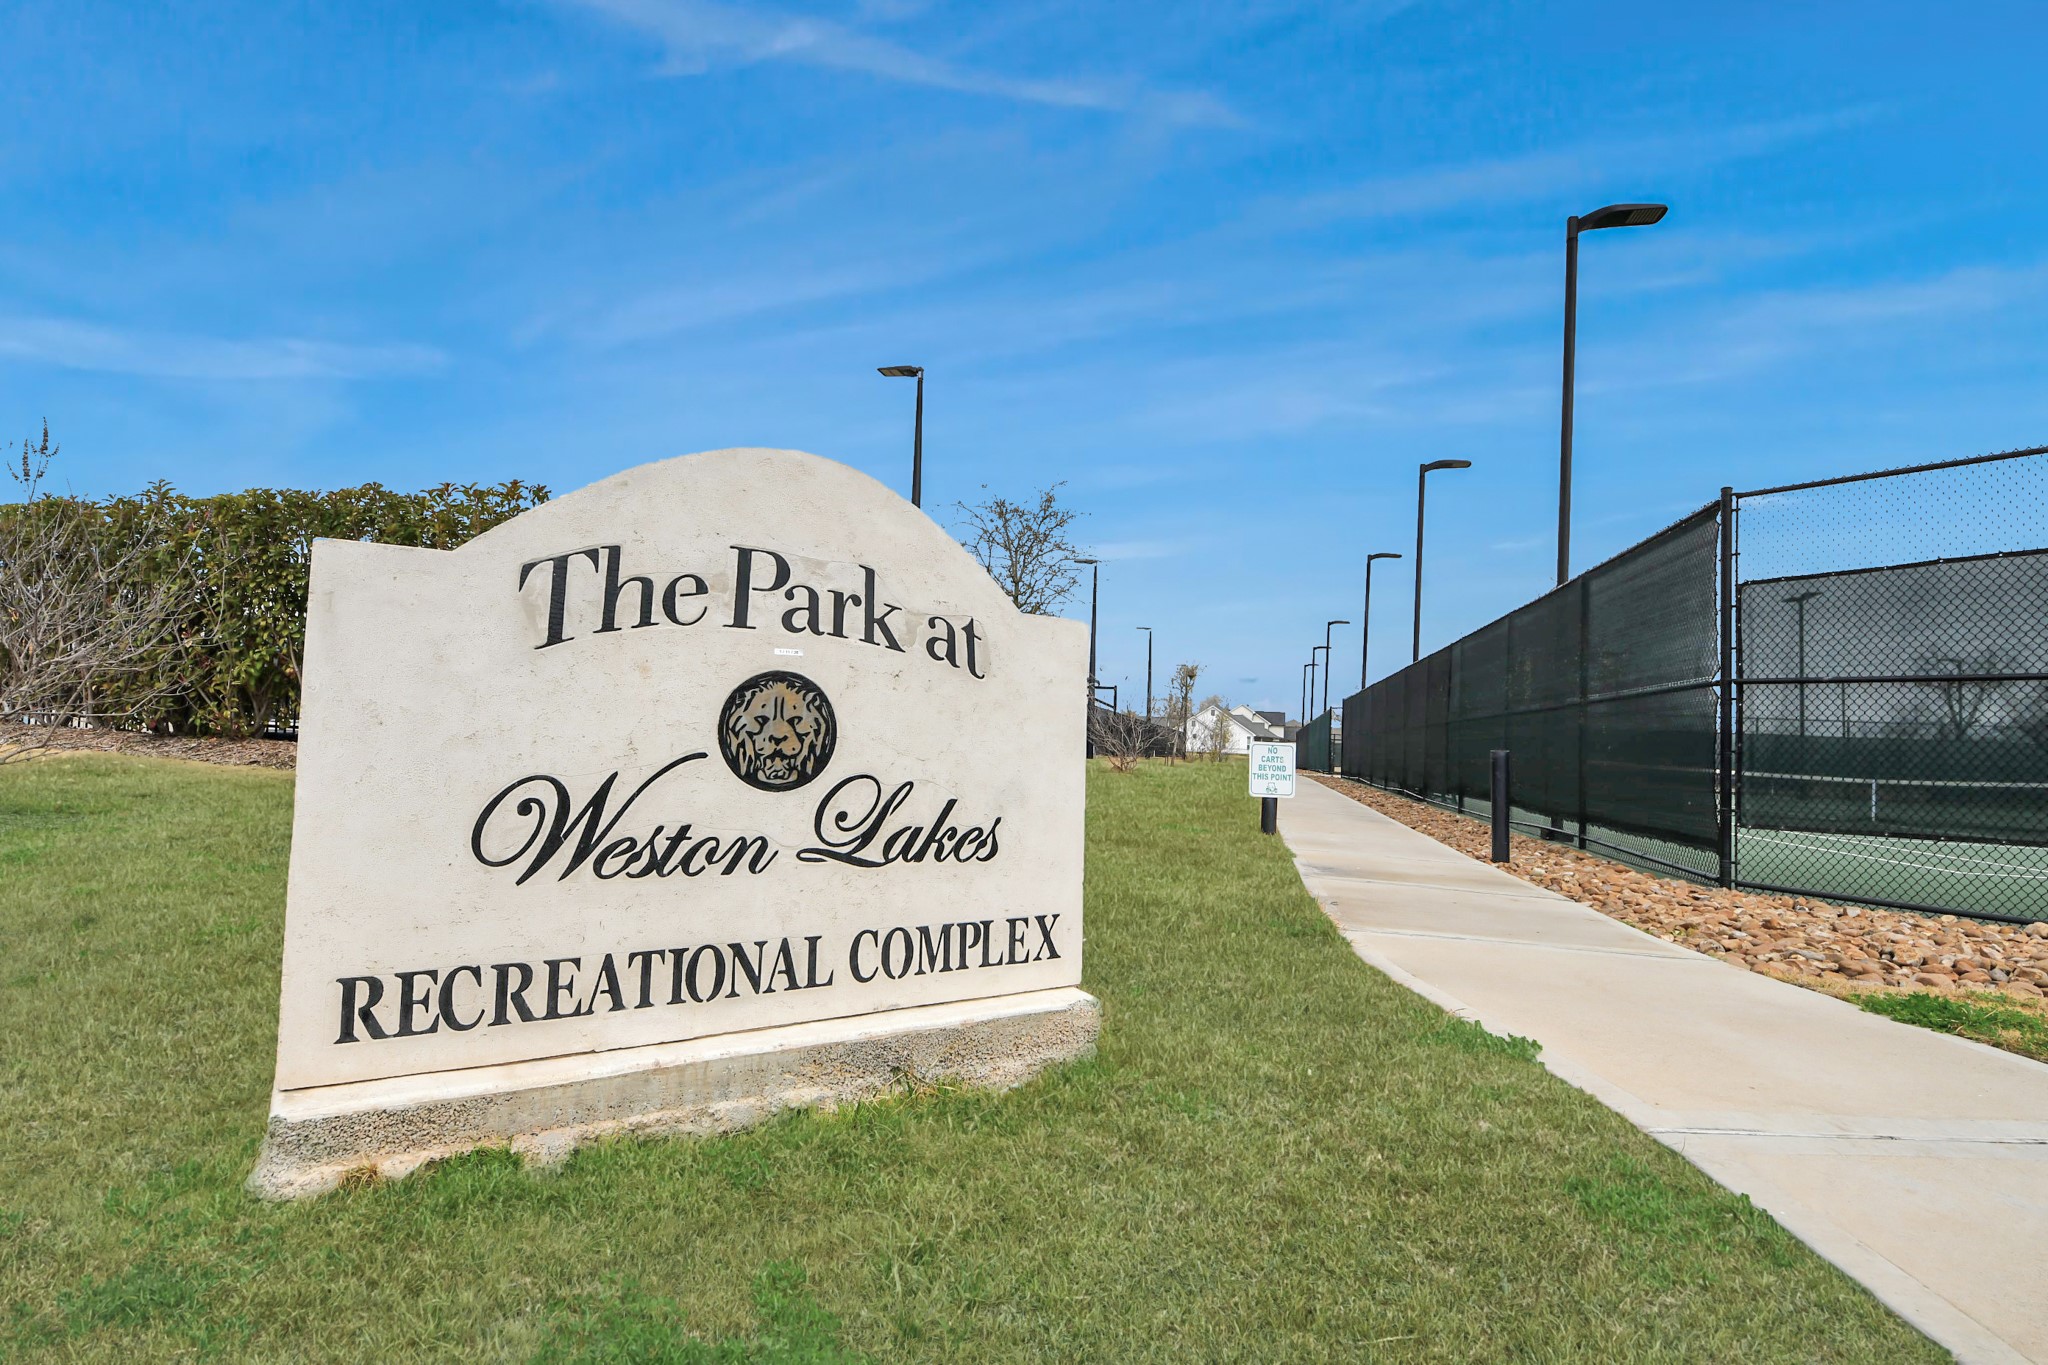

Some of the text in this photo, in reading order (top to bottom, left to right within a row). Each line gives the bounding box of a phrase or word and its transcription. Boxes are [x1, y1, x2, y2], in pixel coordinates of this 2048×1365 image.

[519, 545, 985, 680] The Park at
[472, 752, 1002, 886] Weston Lakes
[1258, 764, 1287, 772] BEYOND
[1261, 755, 1284, 763] CARTS
[334, 913, 1061, 1044] RECREATIONAL COMPLEX
